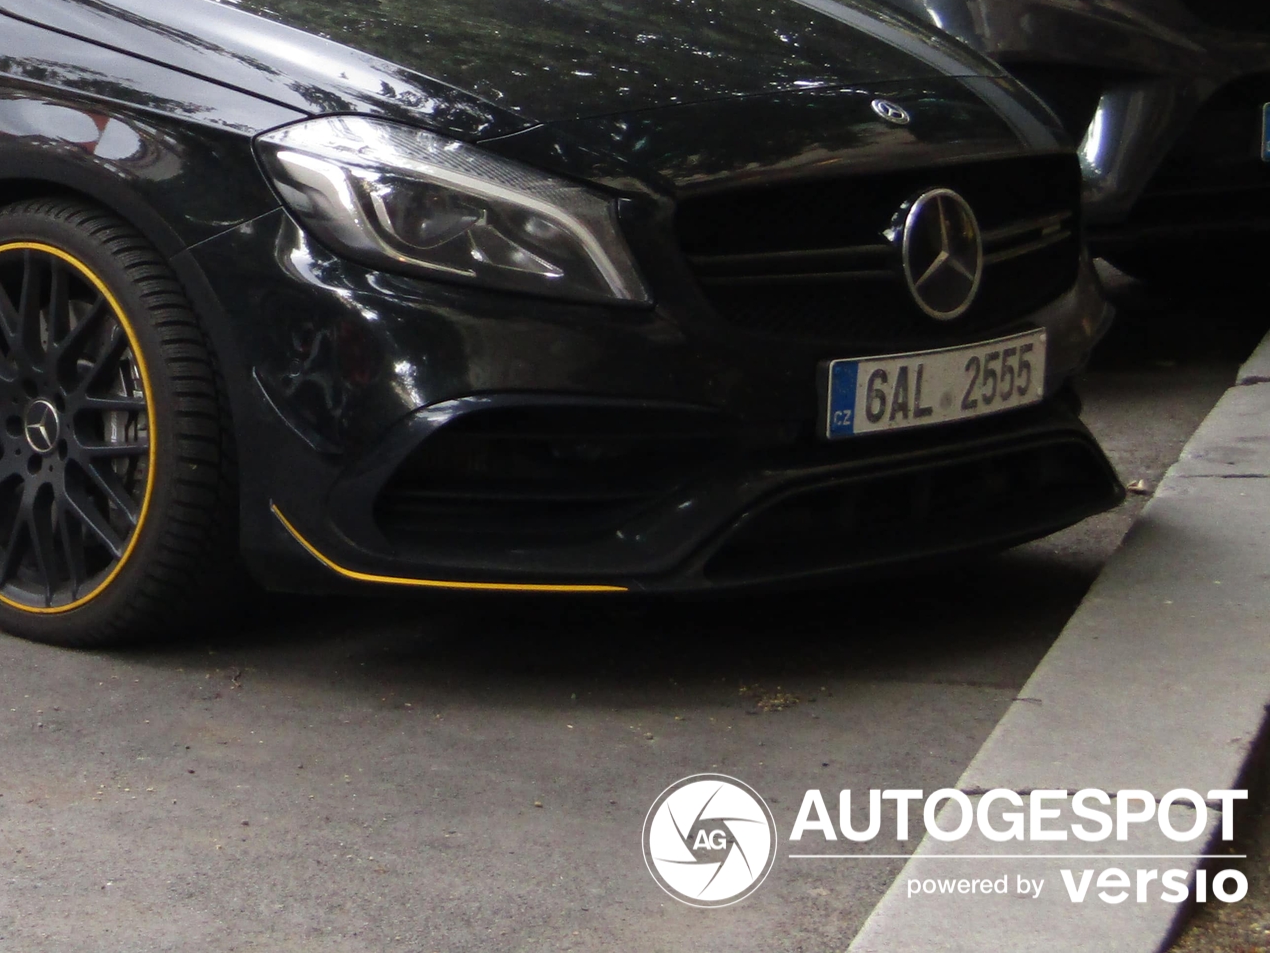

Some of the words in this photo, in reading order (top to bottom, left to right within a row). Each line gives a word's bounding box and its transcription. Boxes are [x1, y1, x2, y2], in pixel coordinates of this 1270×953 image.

[865, 363, 933, 424] 6AL
[961, 343, 1034, 410] 2555
[833, 409, 852, 426] CZ
